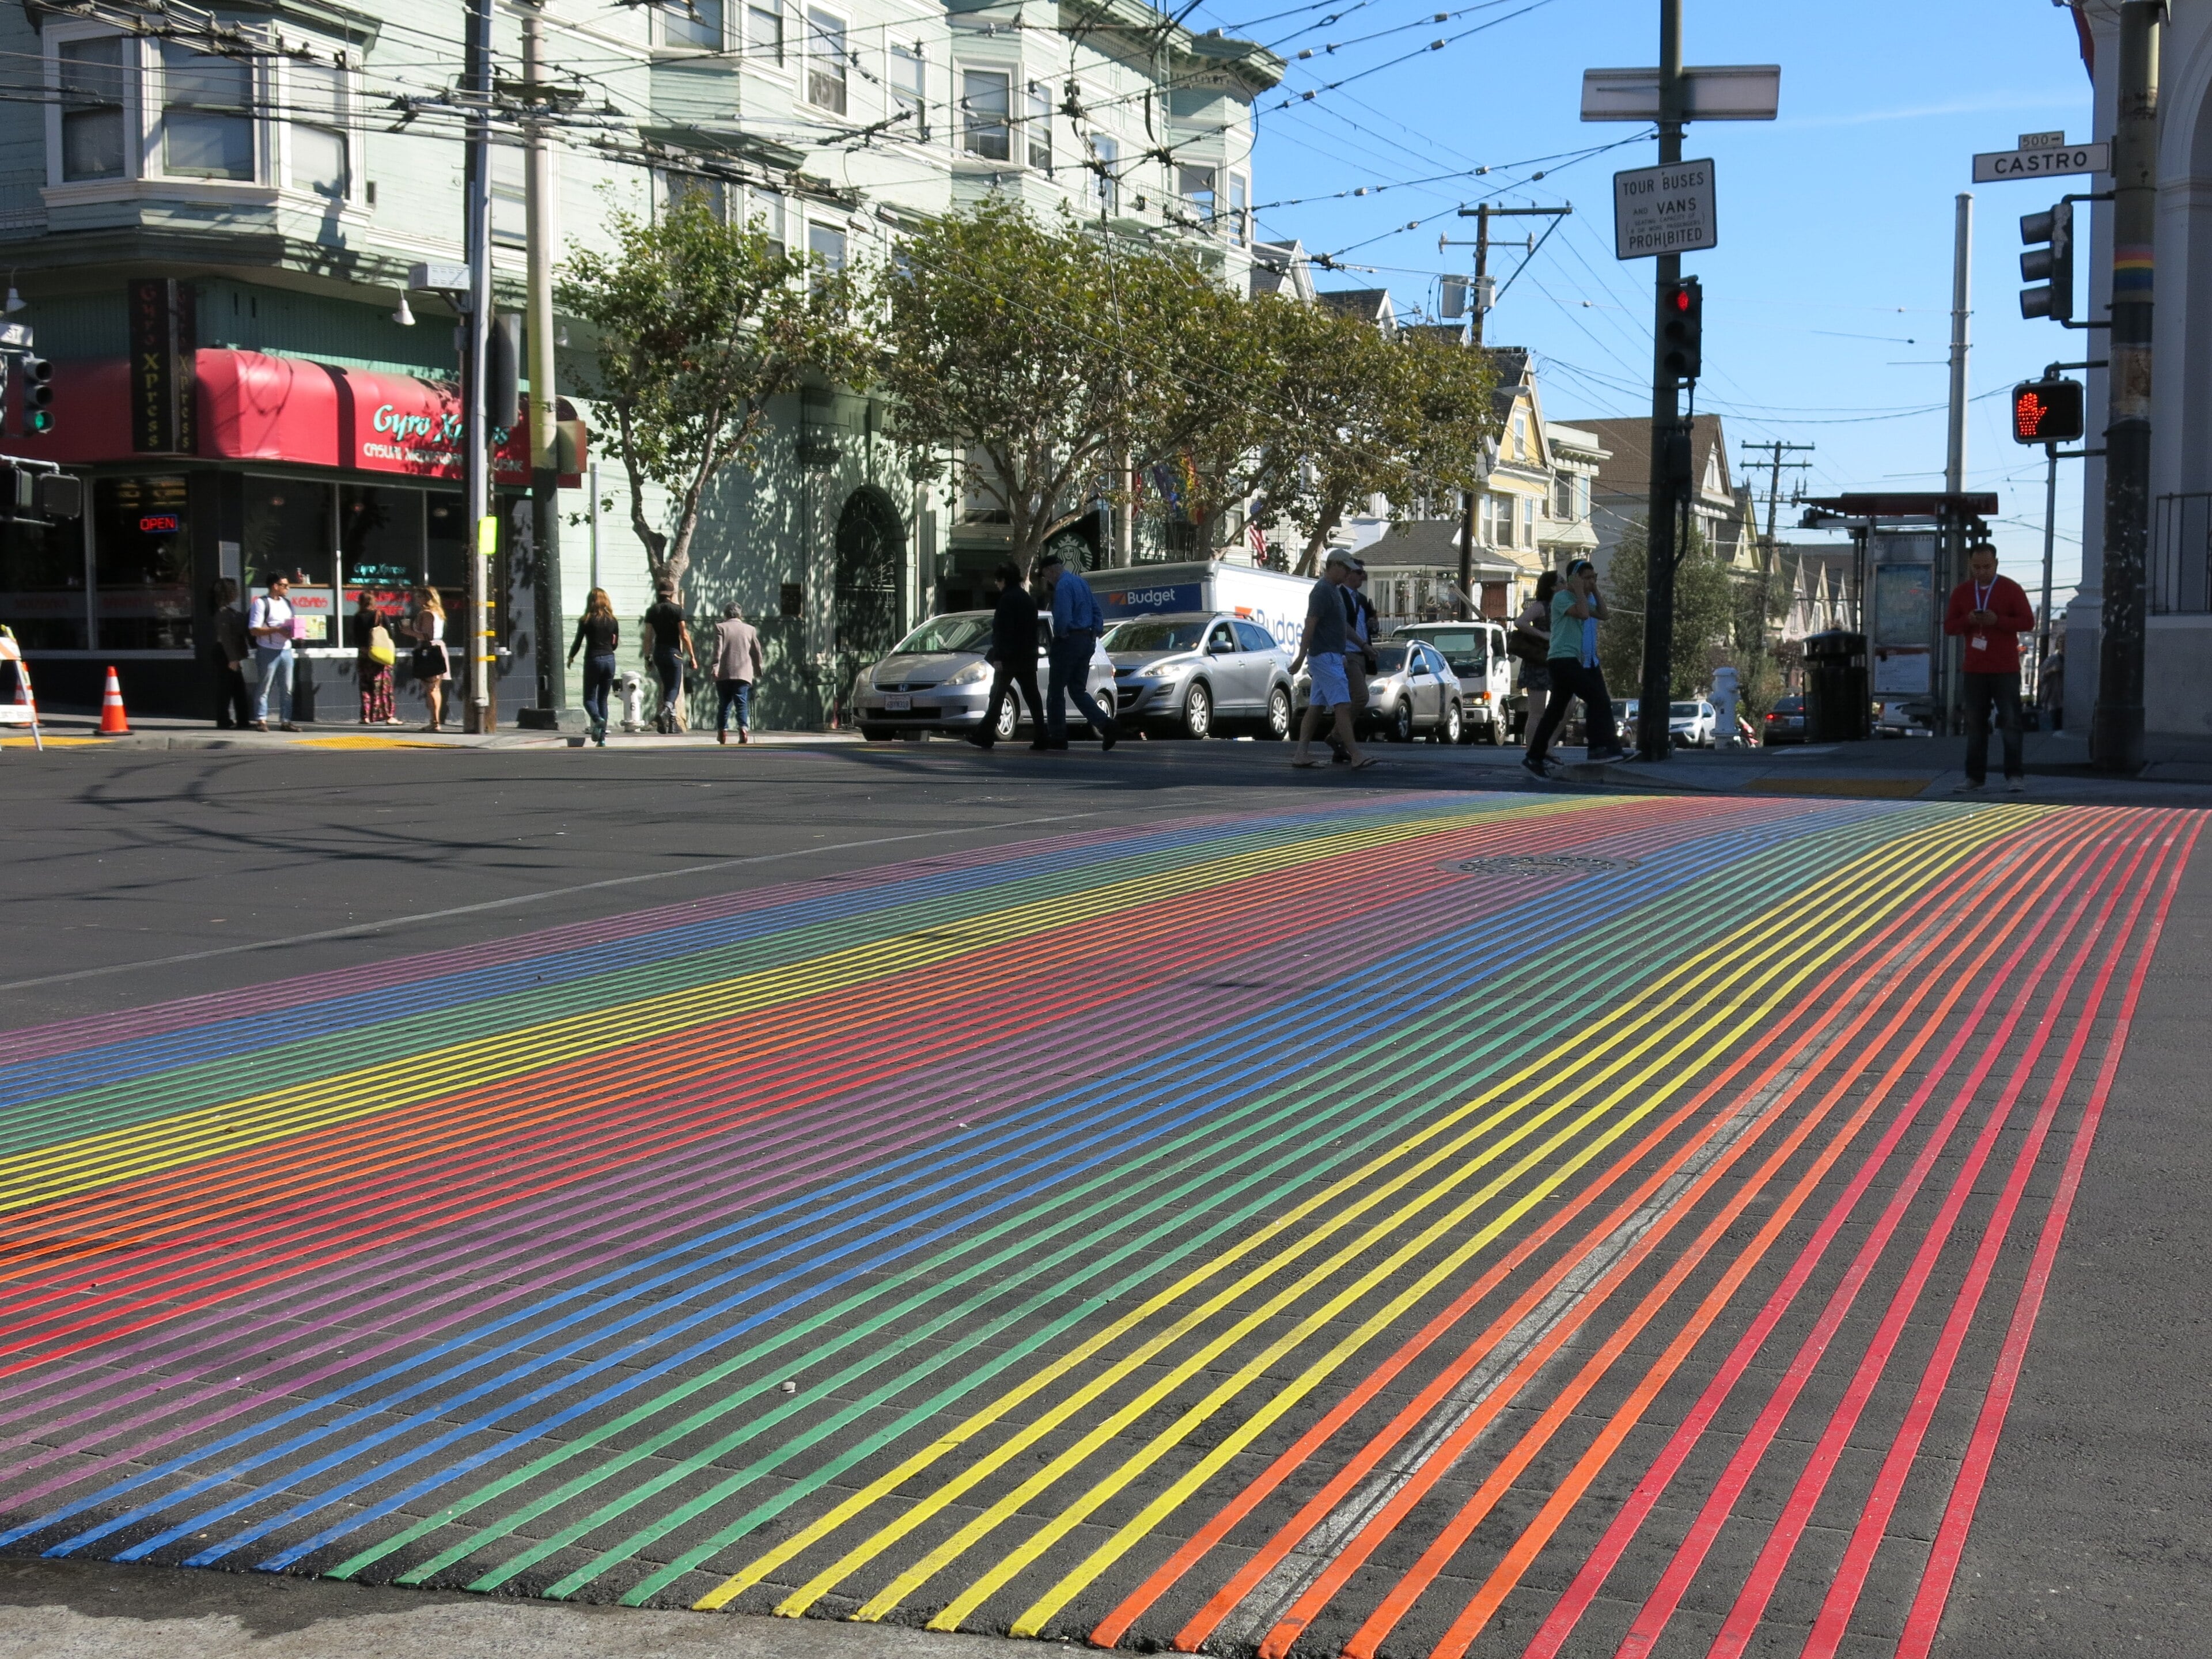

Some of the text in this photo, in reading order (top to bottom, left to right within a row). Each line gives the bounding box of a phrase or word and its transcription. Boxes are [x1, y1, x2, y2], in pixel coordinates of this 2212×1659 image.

[2022, 135, 2048, 146] 500
[1995, 151, 2087, 173] CASTRO
[1623, 172, 1704, 195] TOUR BUSES
[1633, 197, 1696, 215] AND VANS
[1629, 228, 1702, 249] PROHIBITED
[373, 404, 430, 442] Gyro
[140, 517, 176, 531] OPEN
[1127, 588, 1176, 606] Budget
[1257, 608, 1306, 657] Budge
